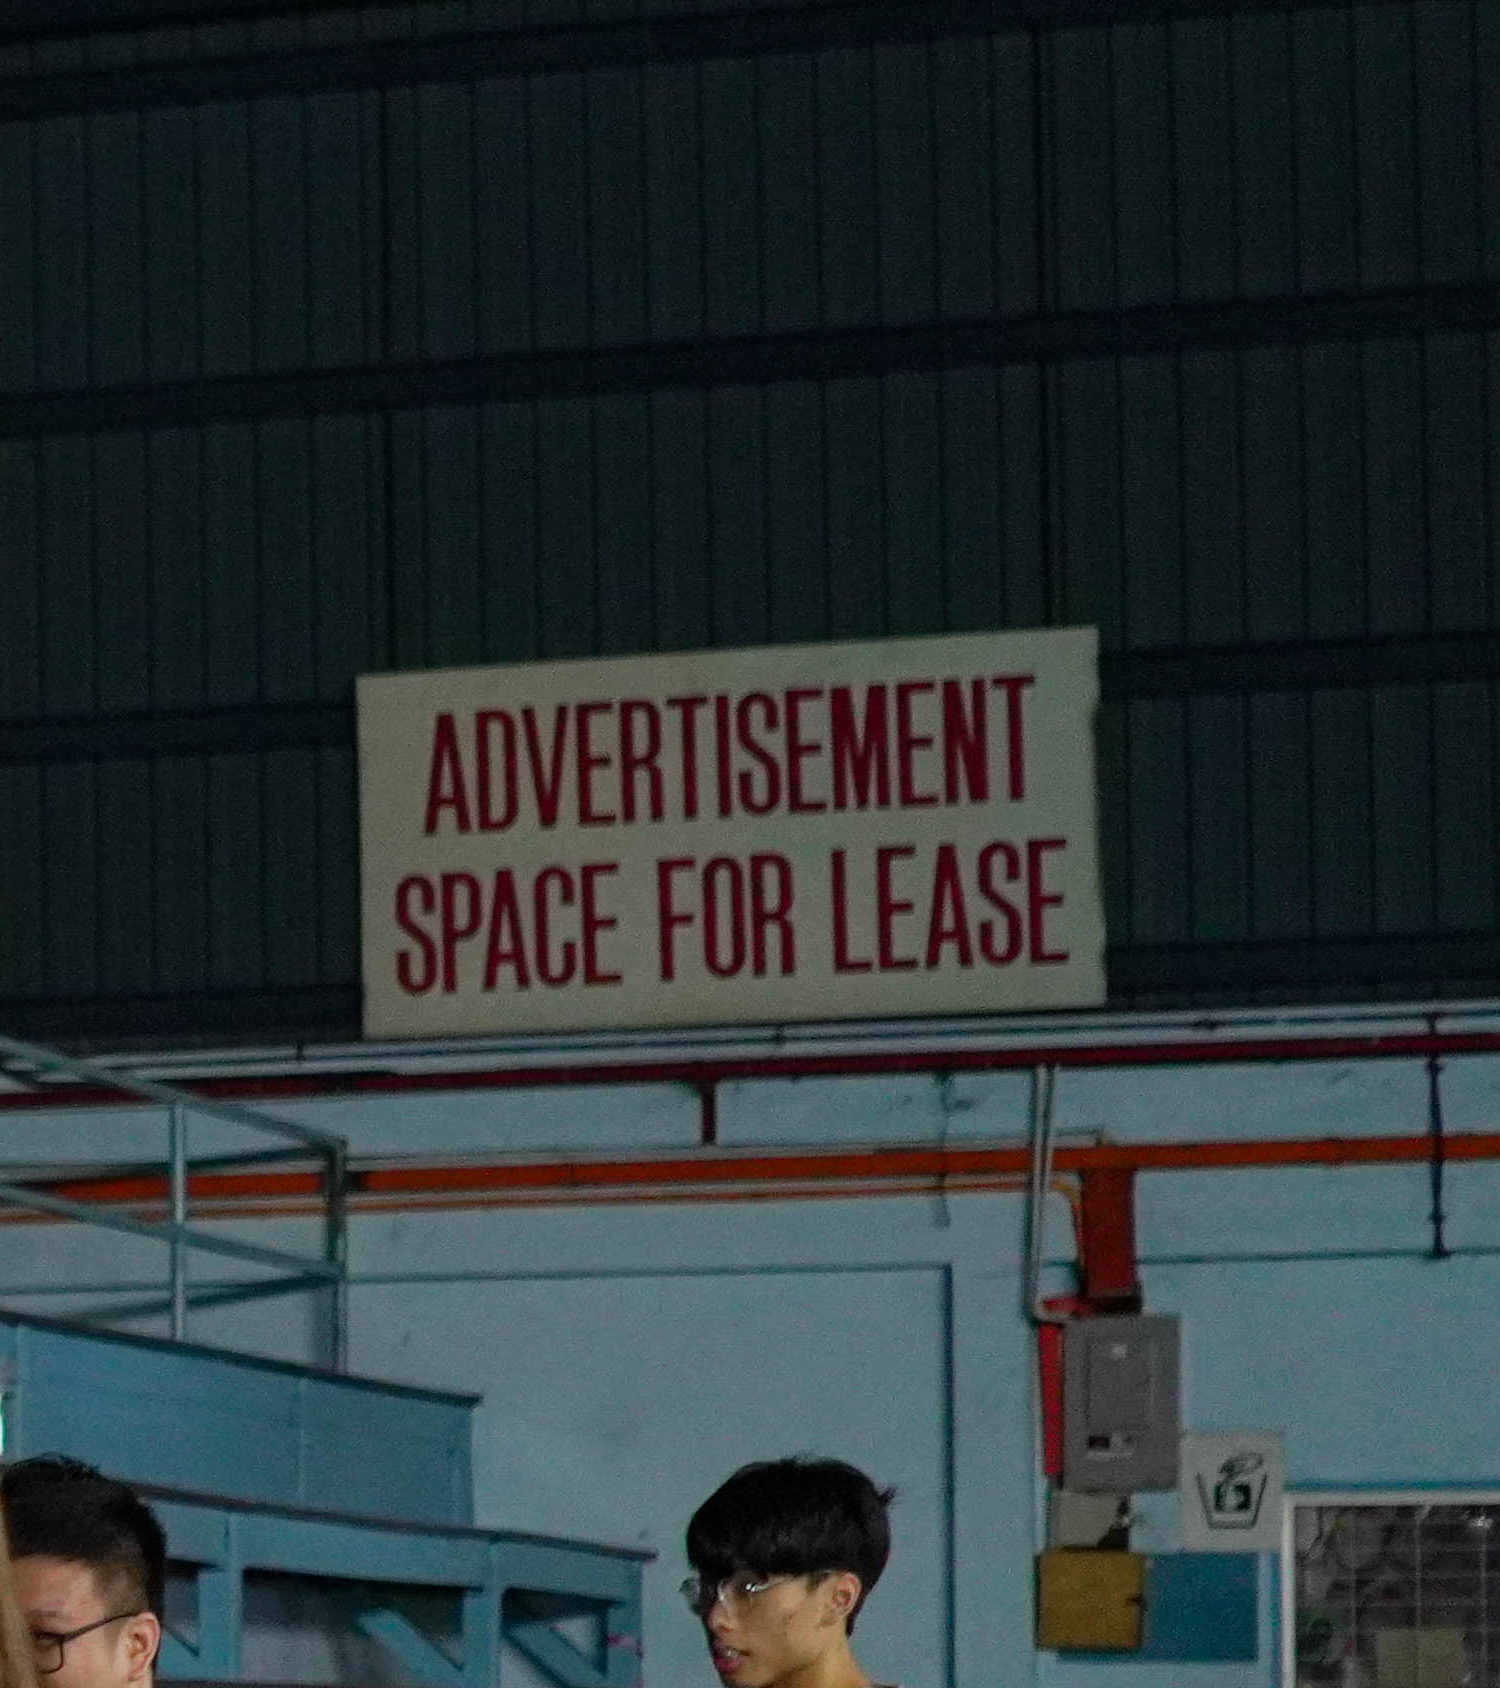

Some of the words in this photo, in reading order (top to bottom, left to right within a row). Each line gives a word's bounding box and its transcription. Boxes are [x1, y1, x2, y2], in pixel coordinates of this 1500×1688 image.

[423, 674, 1036, 836] ADVERTISEMENT
[394, 862, 622, 995] SPACE
[658, 850, 797, 982] FOR
[831, 838, 1070, 975] LEASE
